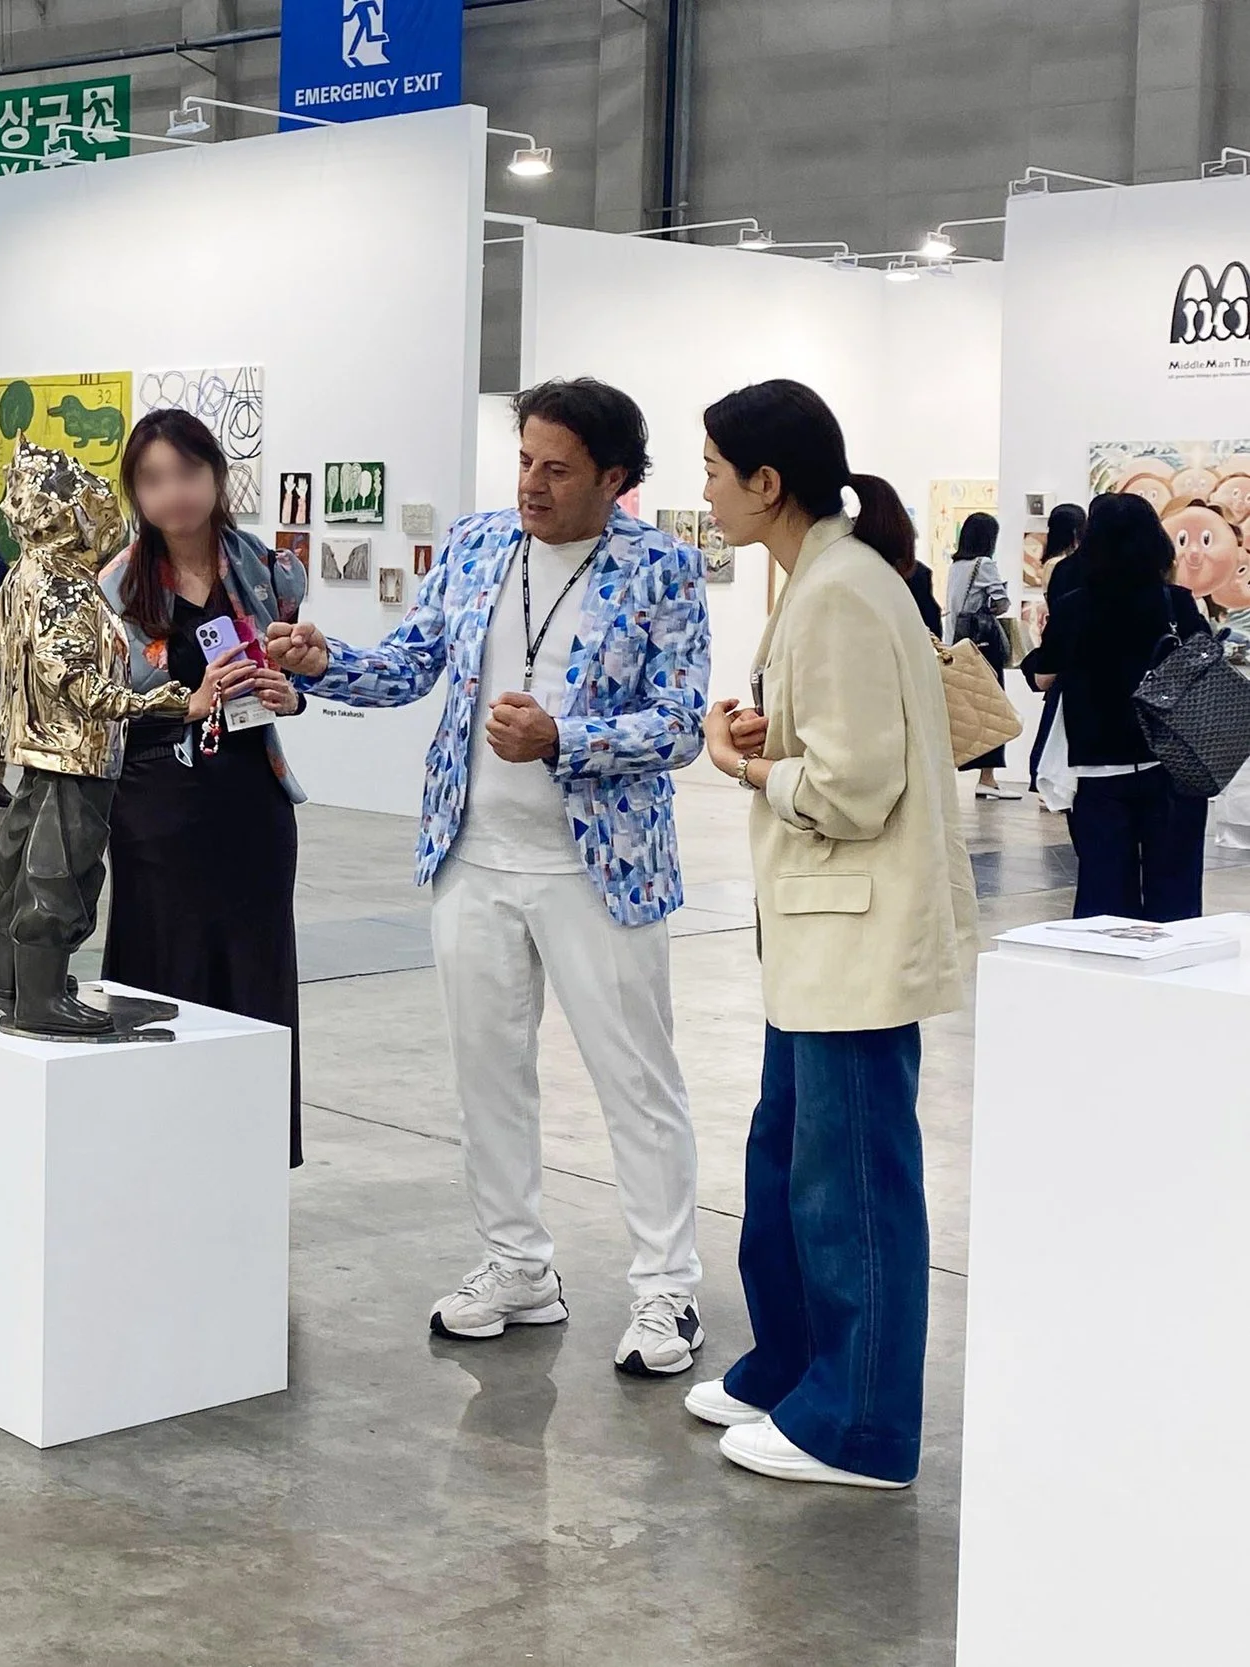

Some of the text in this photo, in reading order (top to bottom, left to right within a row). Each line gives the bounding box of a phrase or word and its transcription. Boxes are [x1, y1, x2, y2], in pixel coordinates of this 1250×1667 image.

[295, 72, 443, 107] EMERGENCY EXIT
[1168, 360, 1205, 370] Middle
[1206, 359, 1230, 369] Man
[97, 389, 112, 405] 32
